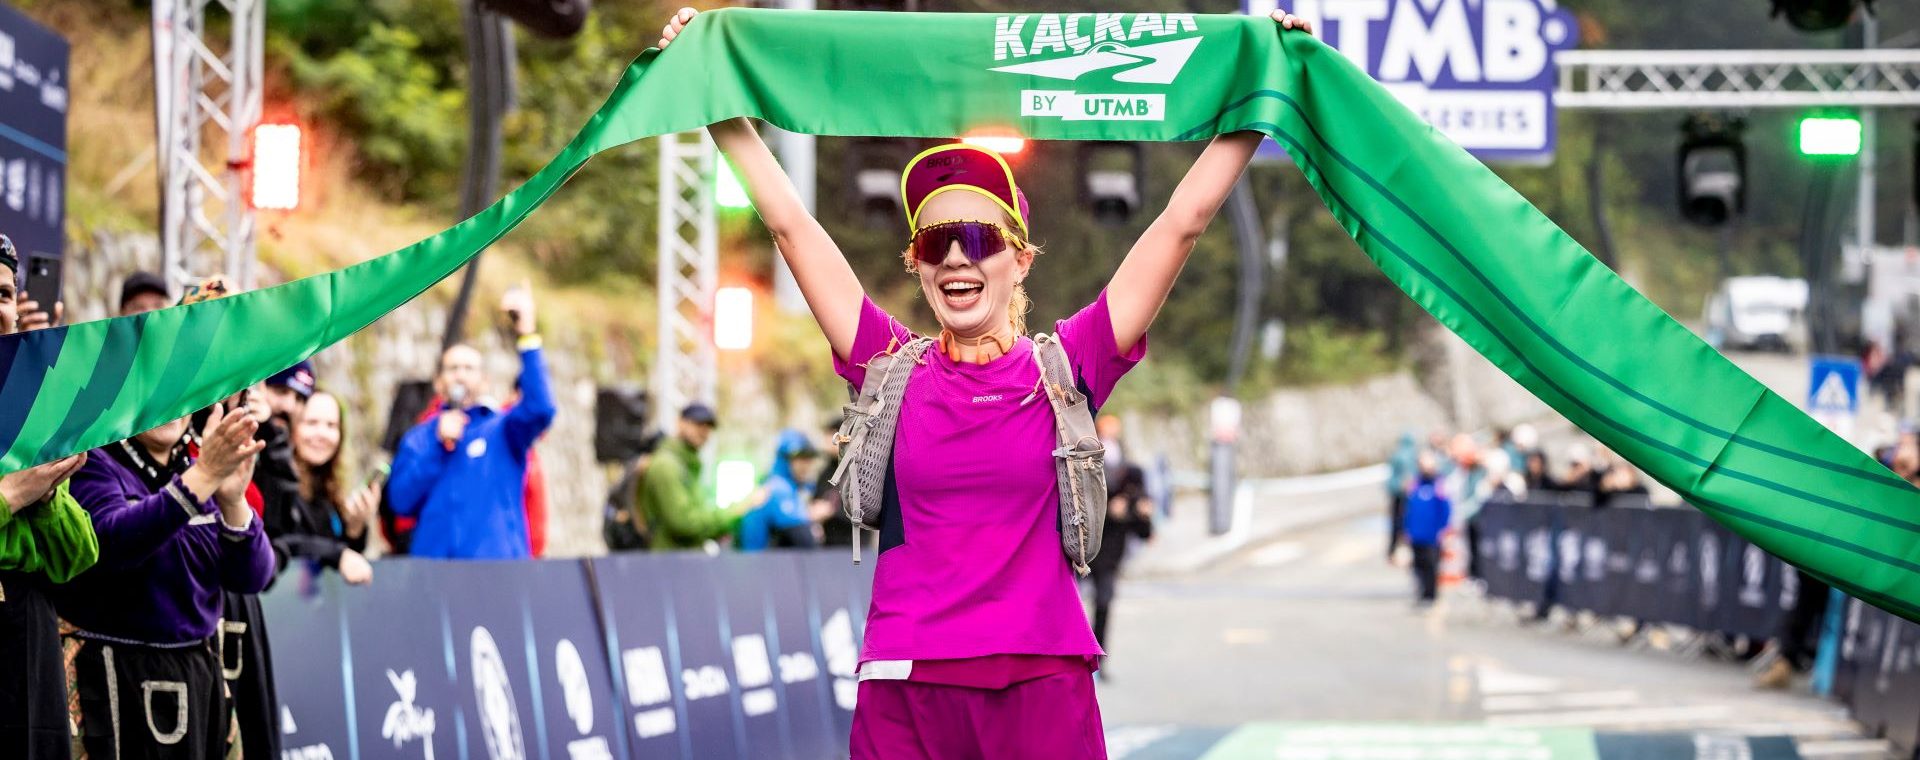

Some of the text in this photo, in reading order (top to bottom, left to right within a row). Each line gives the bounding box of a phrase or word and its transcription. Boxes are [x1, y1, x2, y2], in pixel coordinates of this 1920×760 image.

[1249, 0, 1548, 83] TMB
[1033, 95, 1149, 116] BY UTMB
[972, 394, 1003, 403] BROOKS
